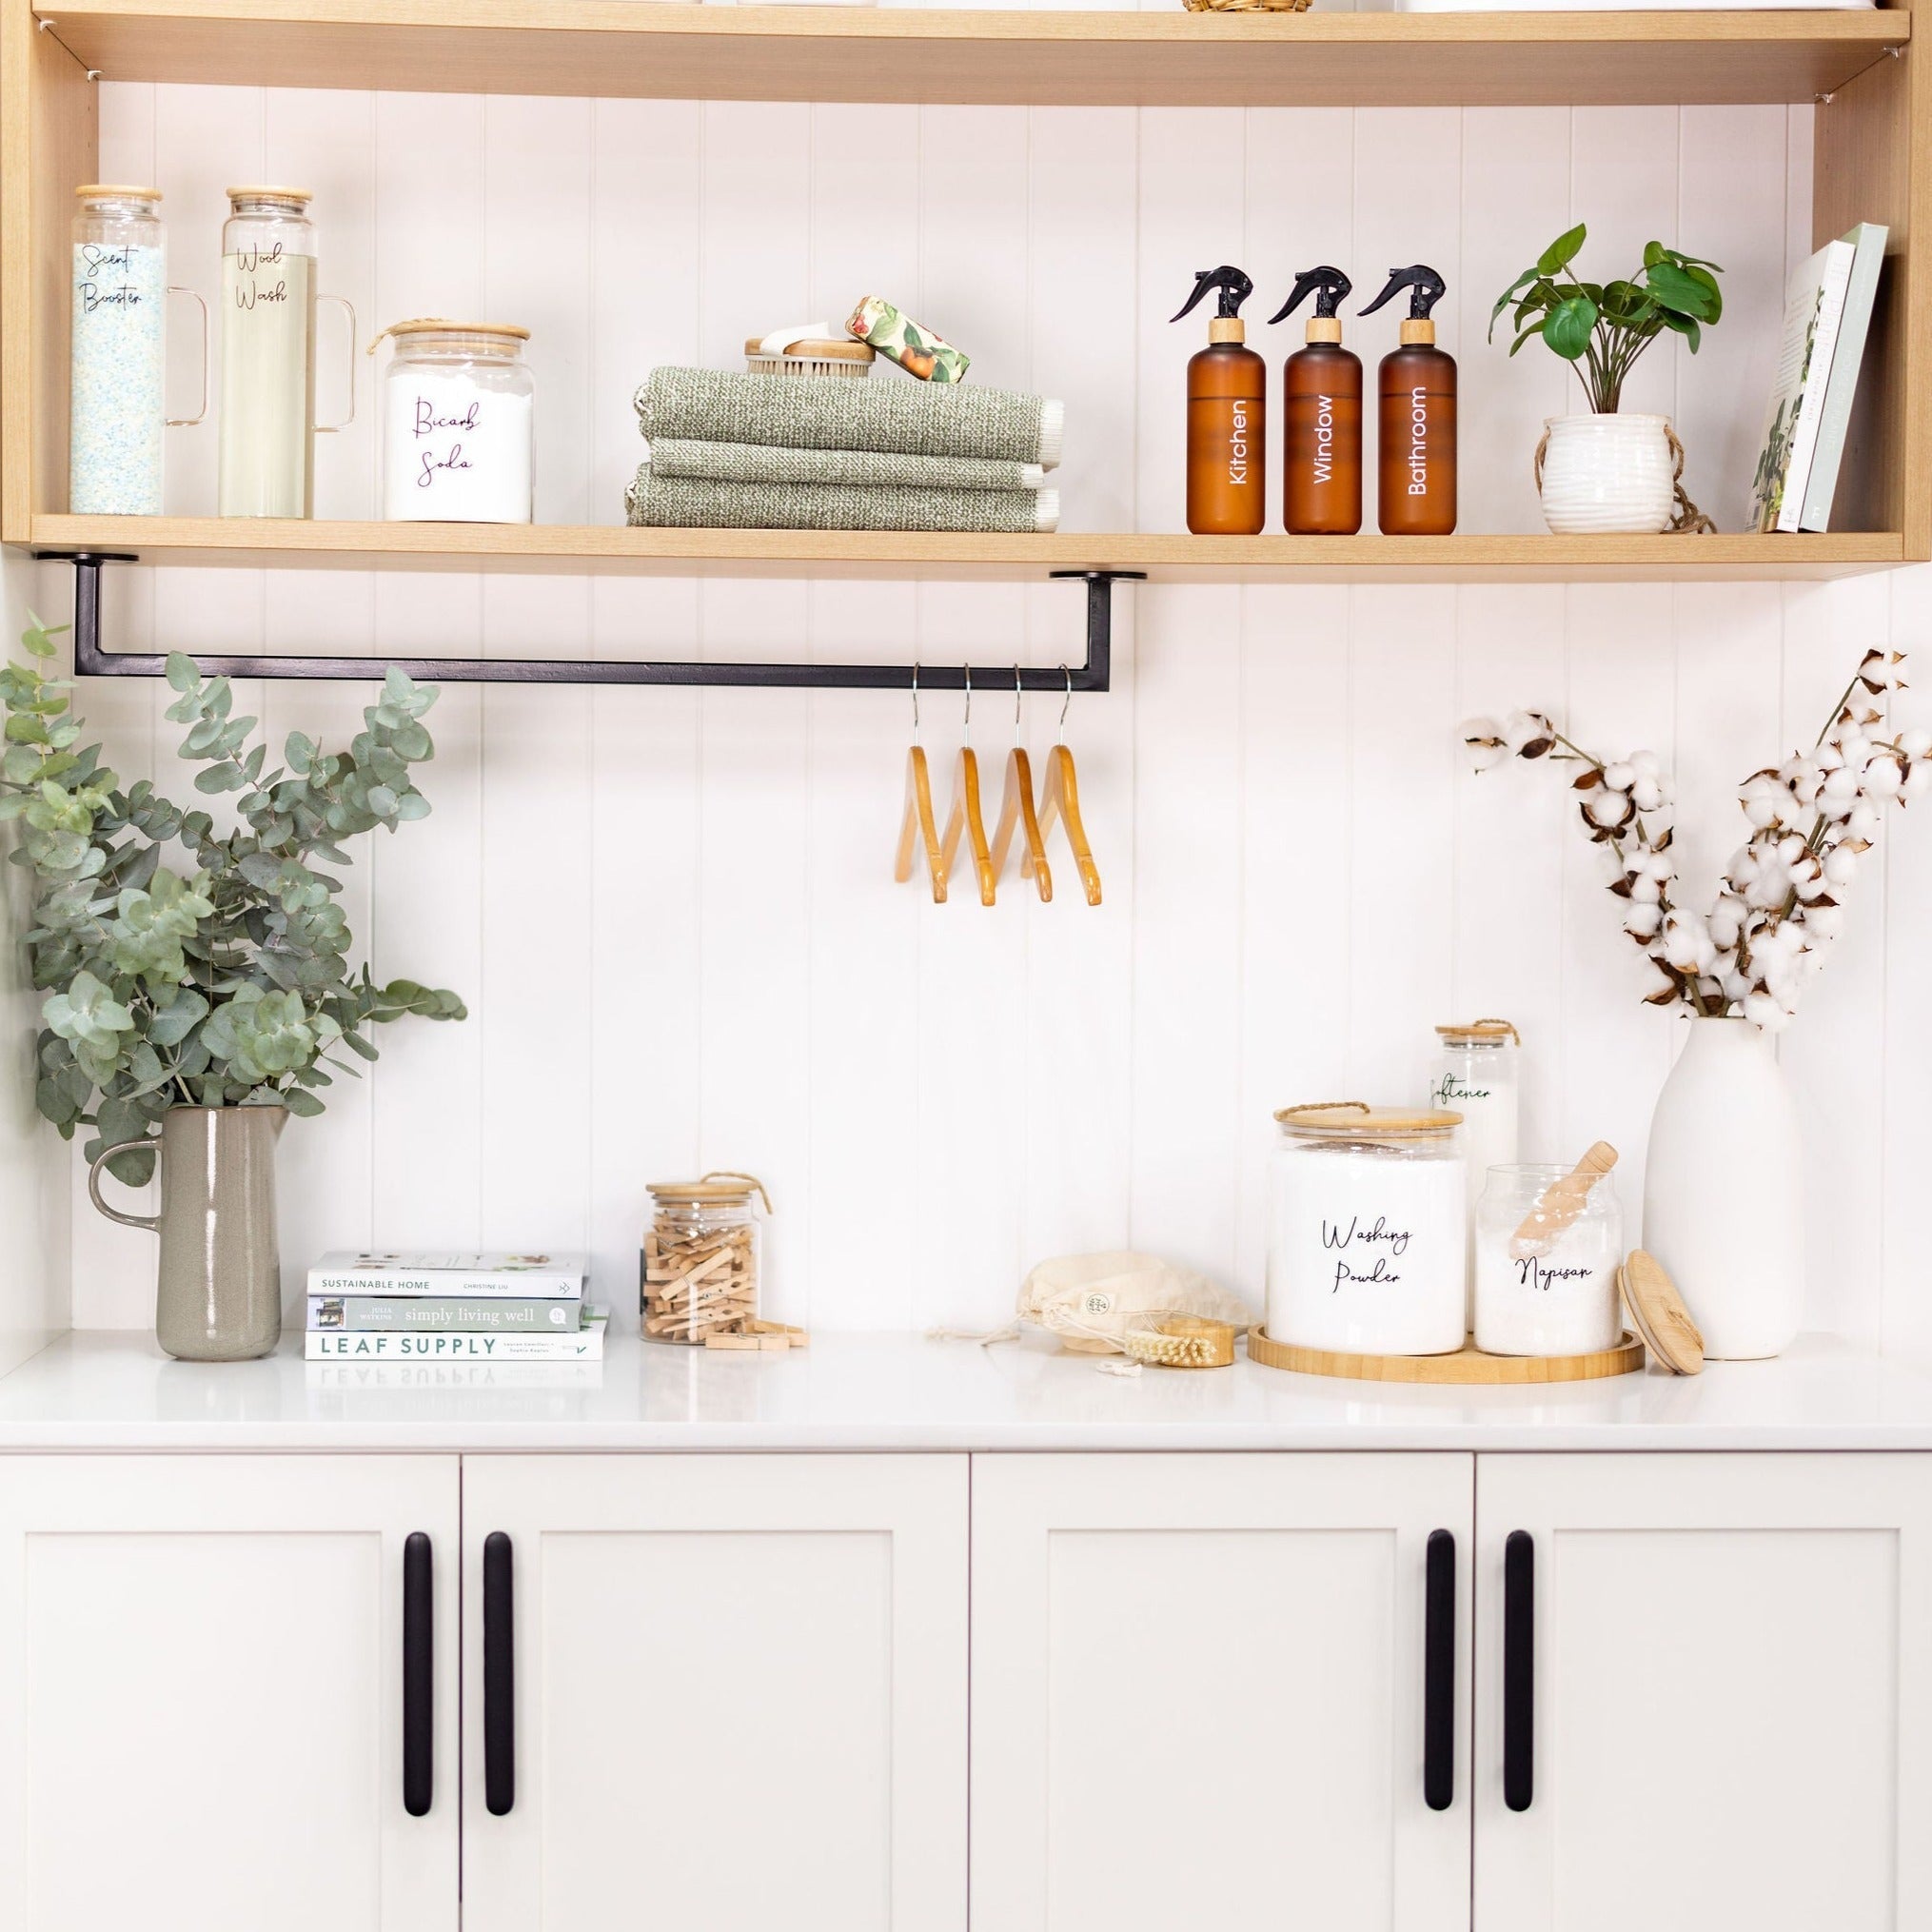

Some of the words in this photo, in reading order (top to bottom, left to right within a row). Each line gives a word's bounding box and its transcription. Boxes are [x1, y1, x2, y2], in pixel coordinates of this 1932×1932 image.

[82, 245, 139, 278] Scent
[236, 242, 283, 273] Wool
[78, 282, 143, 314] Booster
[235, 280, 287, 310] Wash
[411, 395, 481, 440] Bicarb
[1229, 400, 1247, 485] Kitchen
[1313, 394, 1333, 484] Window
[1408, 386, 1427, 496] Bathroom
[417, 444, 473, 488] Soda
[1322, 1215, 1414, 1256] Washing
[322, 1278, 394, 1289] SUSTAINABLE
[398, 1281, 430, 1290] HOME
[1331, 1257, 1401, 1294] Powder
[1514, 1255, 1593, 1291] Napisan
[404, 1307, 454, 1326] simply
[458, 1307, 501, 1326] living
[504, 1308, 535, 1322] well
[321, 1337, 388, 1354] LEAF
[400, 1338, 497, 1354] SUPPLY
